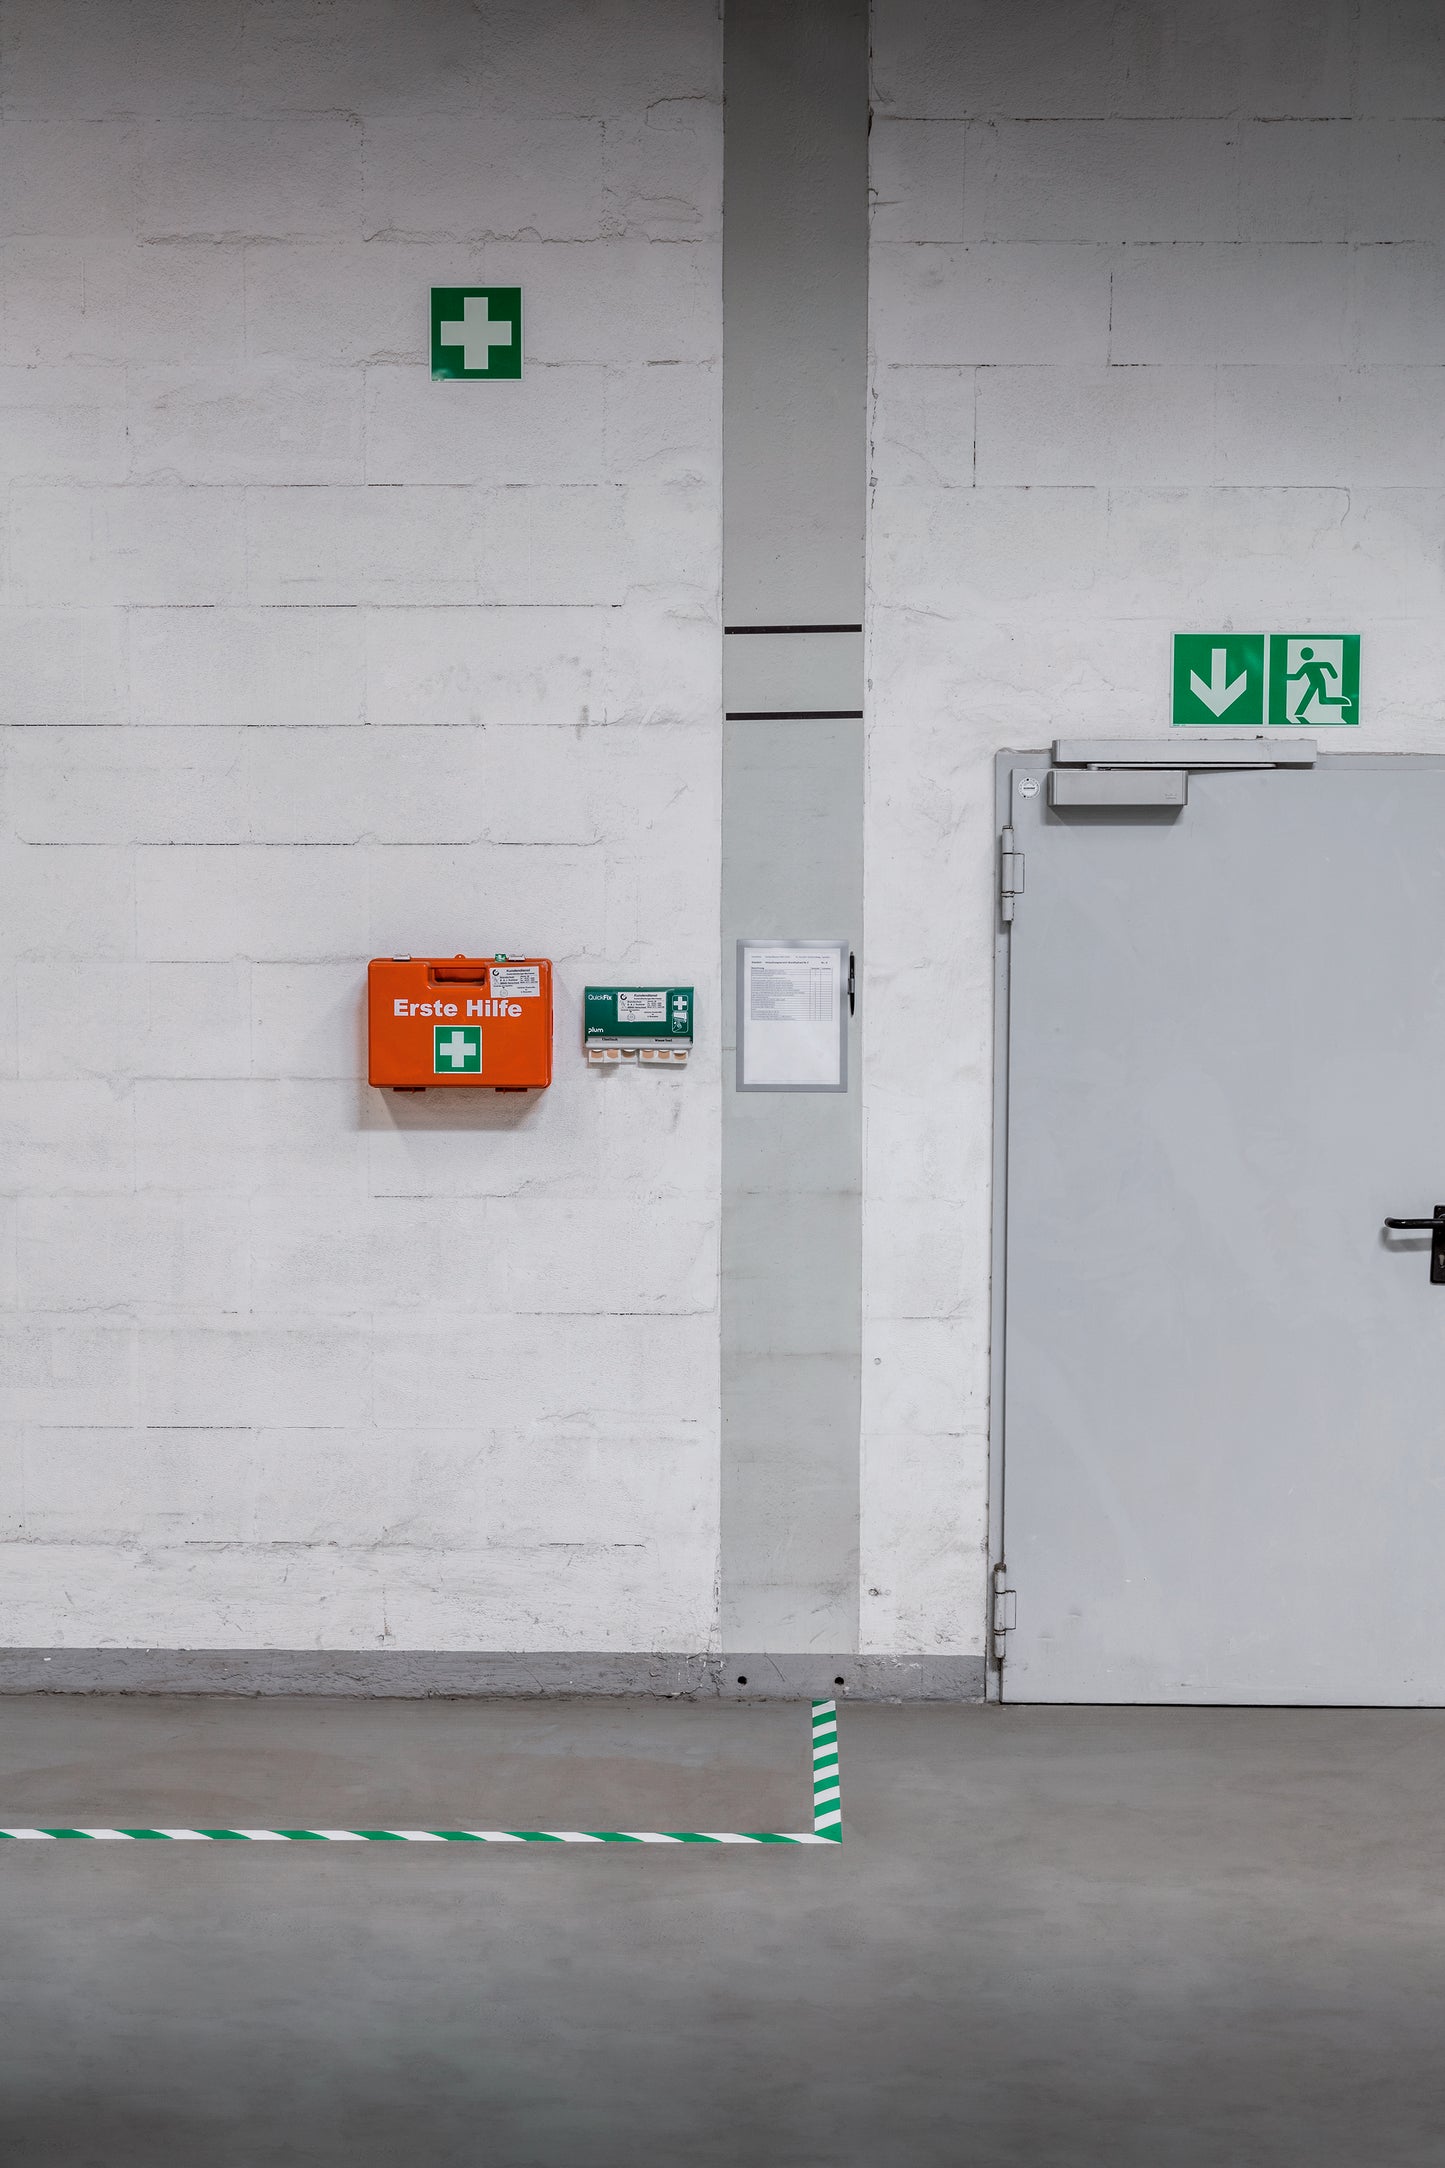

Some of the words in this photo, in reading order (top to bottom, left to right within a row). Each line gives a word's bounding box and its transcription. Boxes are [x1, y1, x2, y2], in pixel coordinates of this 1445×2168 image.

[394, 998, 458, 1017] Erste
[466, 999, 522, 1017] Hilfe
[587, 1026, 604, 1034] plum
